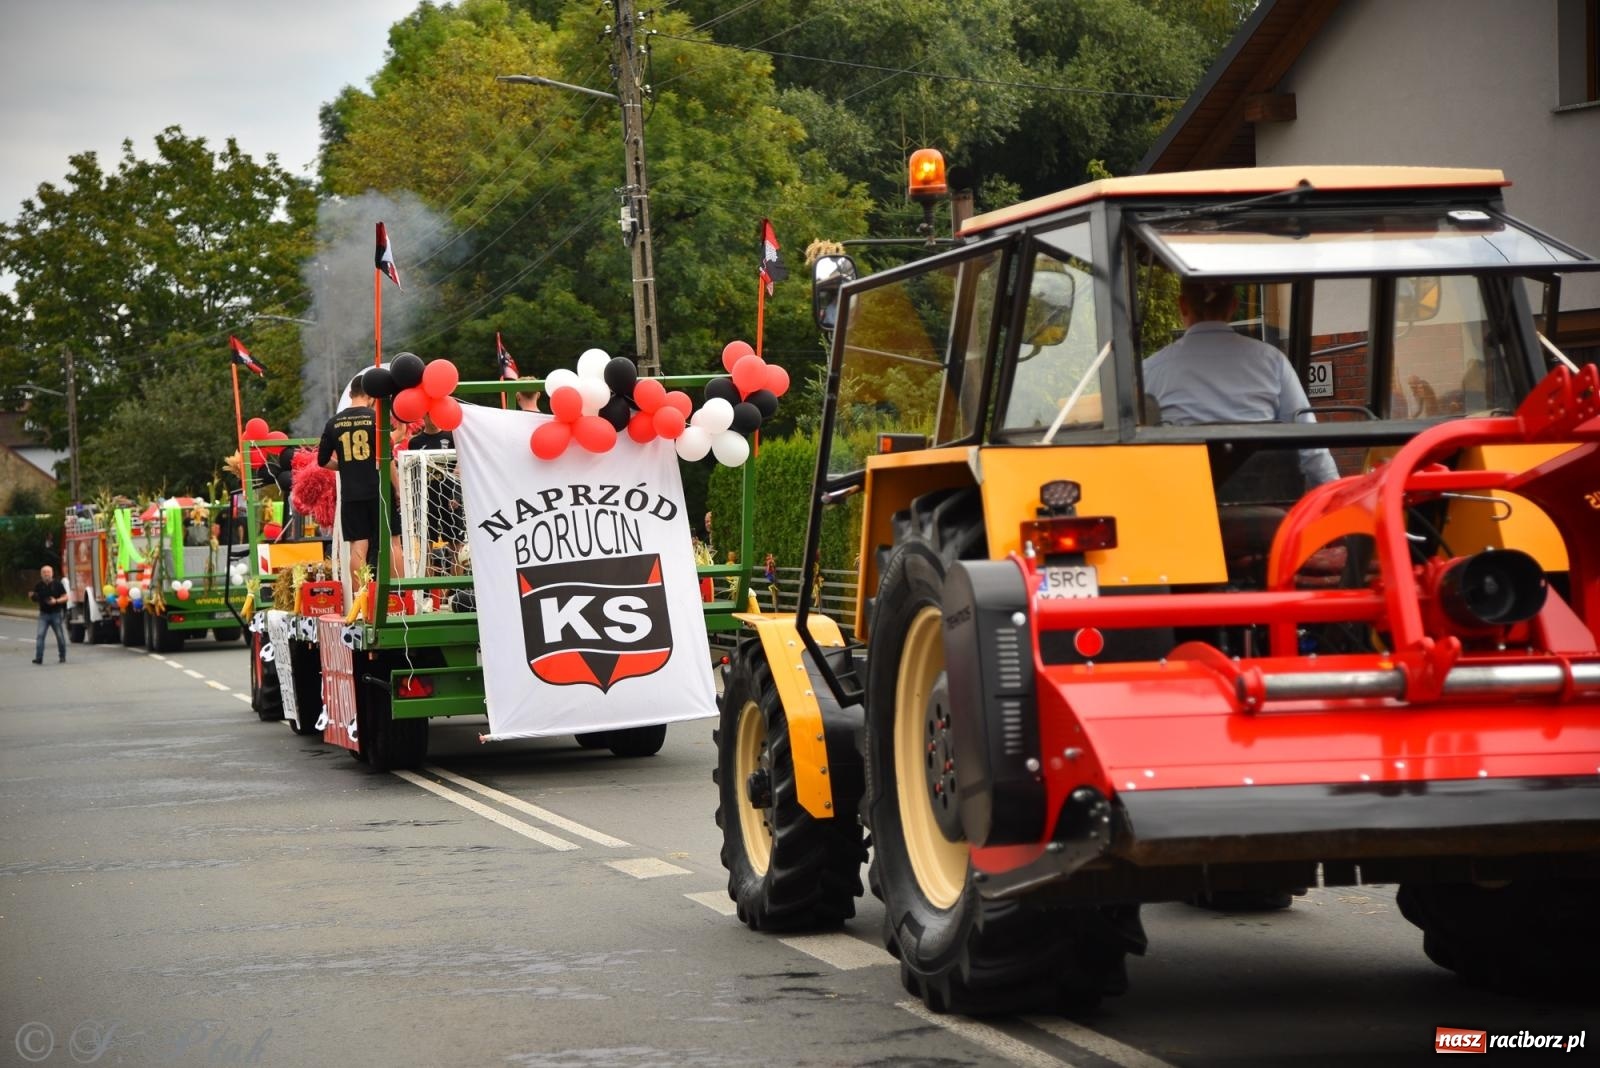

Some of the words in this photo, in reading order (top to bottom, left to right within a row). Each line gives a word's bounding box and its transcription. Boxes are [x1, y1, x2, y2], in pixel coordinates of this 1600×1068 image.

[1308, 365, 1326, 383] 30
[338, 429, 371, 462] 18
[478, 482, 678, 543] NAPRZÓD
[515, 508, 643, 565] BORUCIN
[1049, 571, 1087, 588] SRC
[310, 605, 335, 615] TYSKIE
[539, 595, 653, 643] KS
